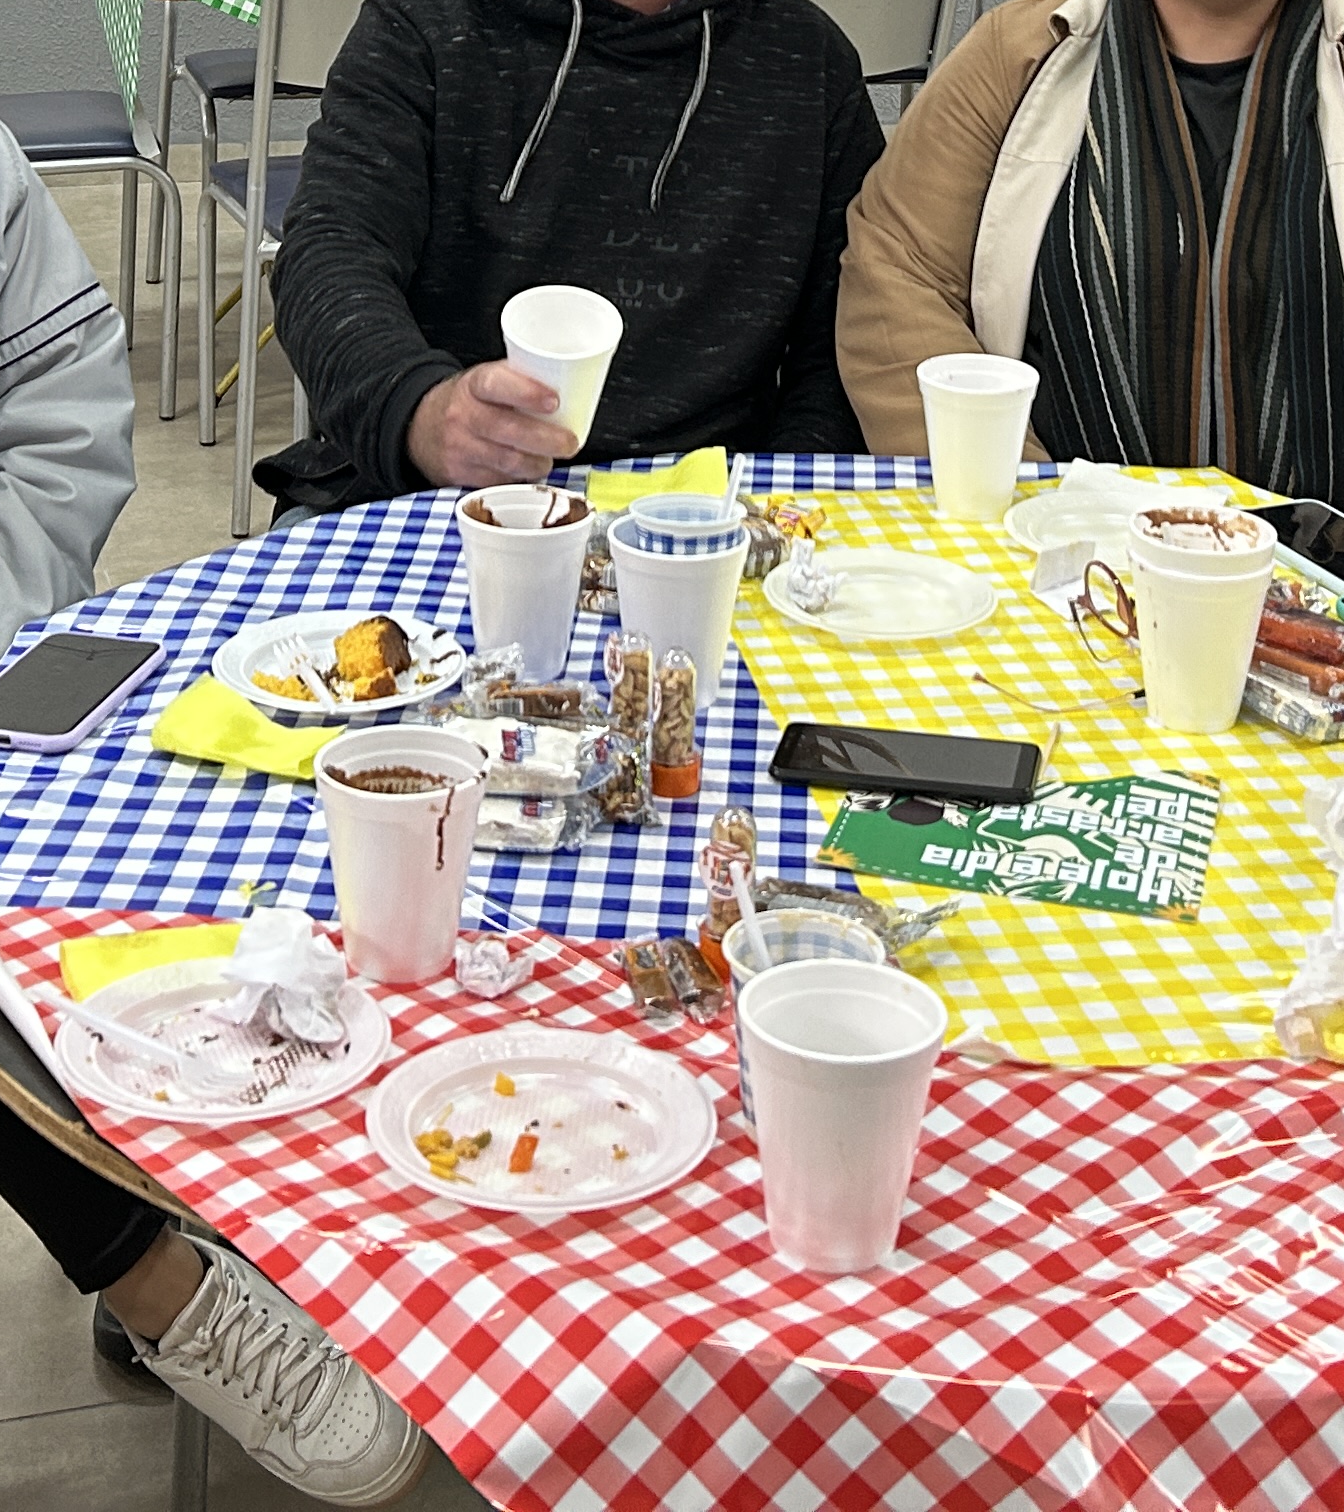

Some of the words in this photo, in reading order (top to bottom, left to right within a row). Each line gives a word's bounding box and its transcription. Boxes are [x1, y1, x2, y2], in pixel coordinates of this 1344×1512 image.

[920, 843, 999, 878] dia
[1012, 854, 1045, 880] é
[1114, 843, 1180, 875] de
[1058, 859, 1175, 905] Hoje
